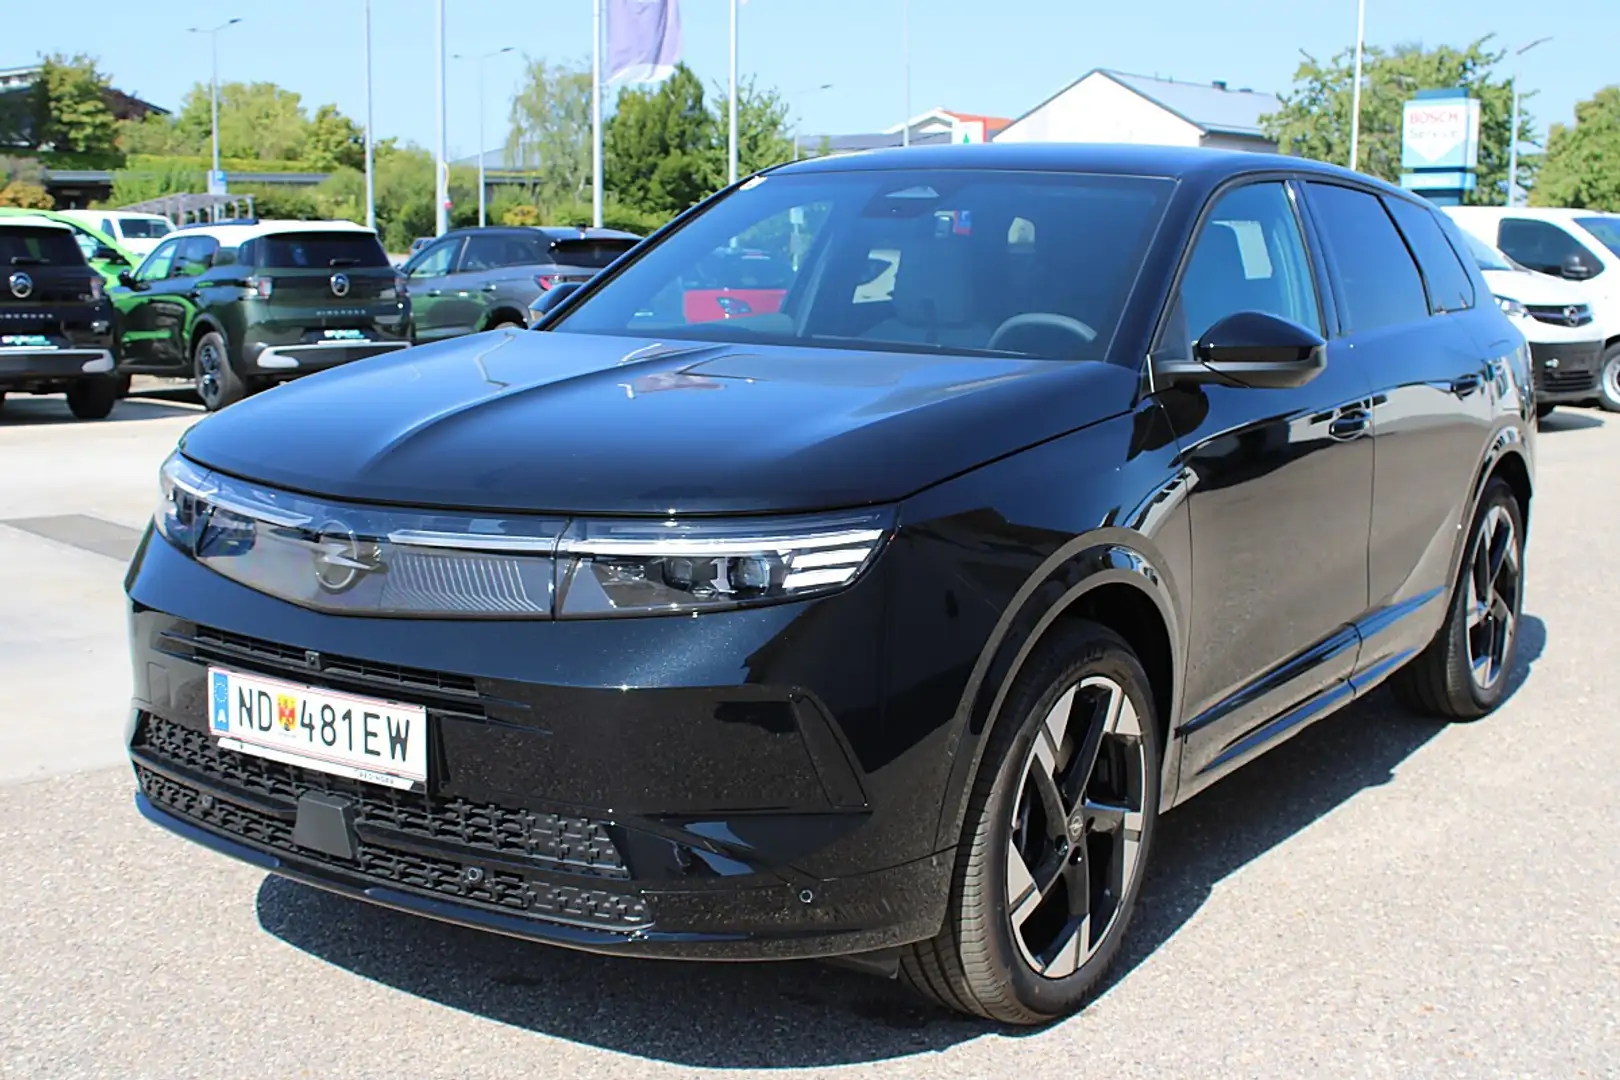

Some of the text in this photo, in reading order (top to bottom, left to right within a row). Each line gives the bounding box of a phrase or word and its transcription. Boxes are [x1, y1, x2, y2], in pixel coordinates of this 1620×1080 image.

[1410, 111, 1458, 124] BOSCH
[238, 685, 411, 762] ND 481EW
